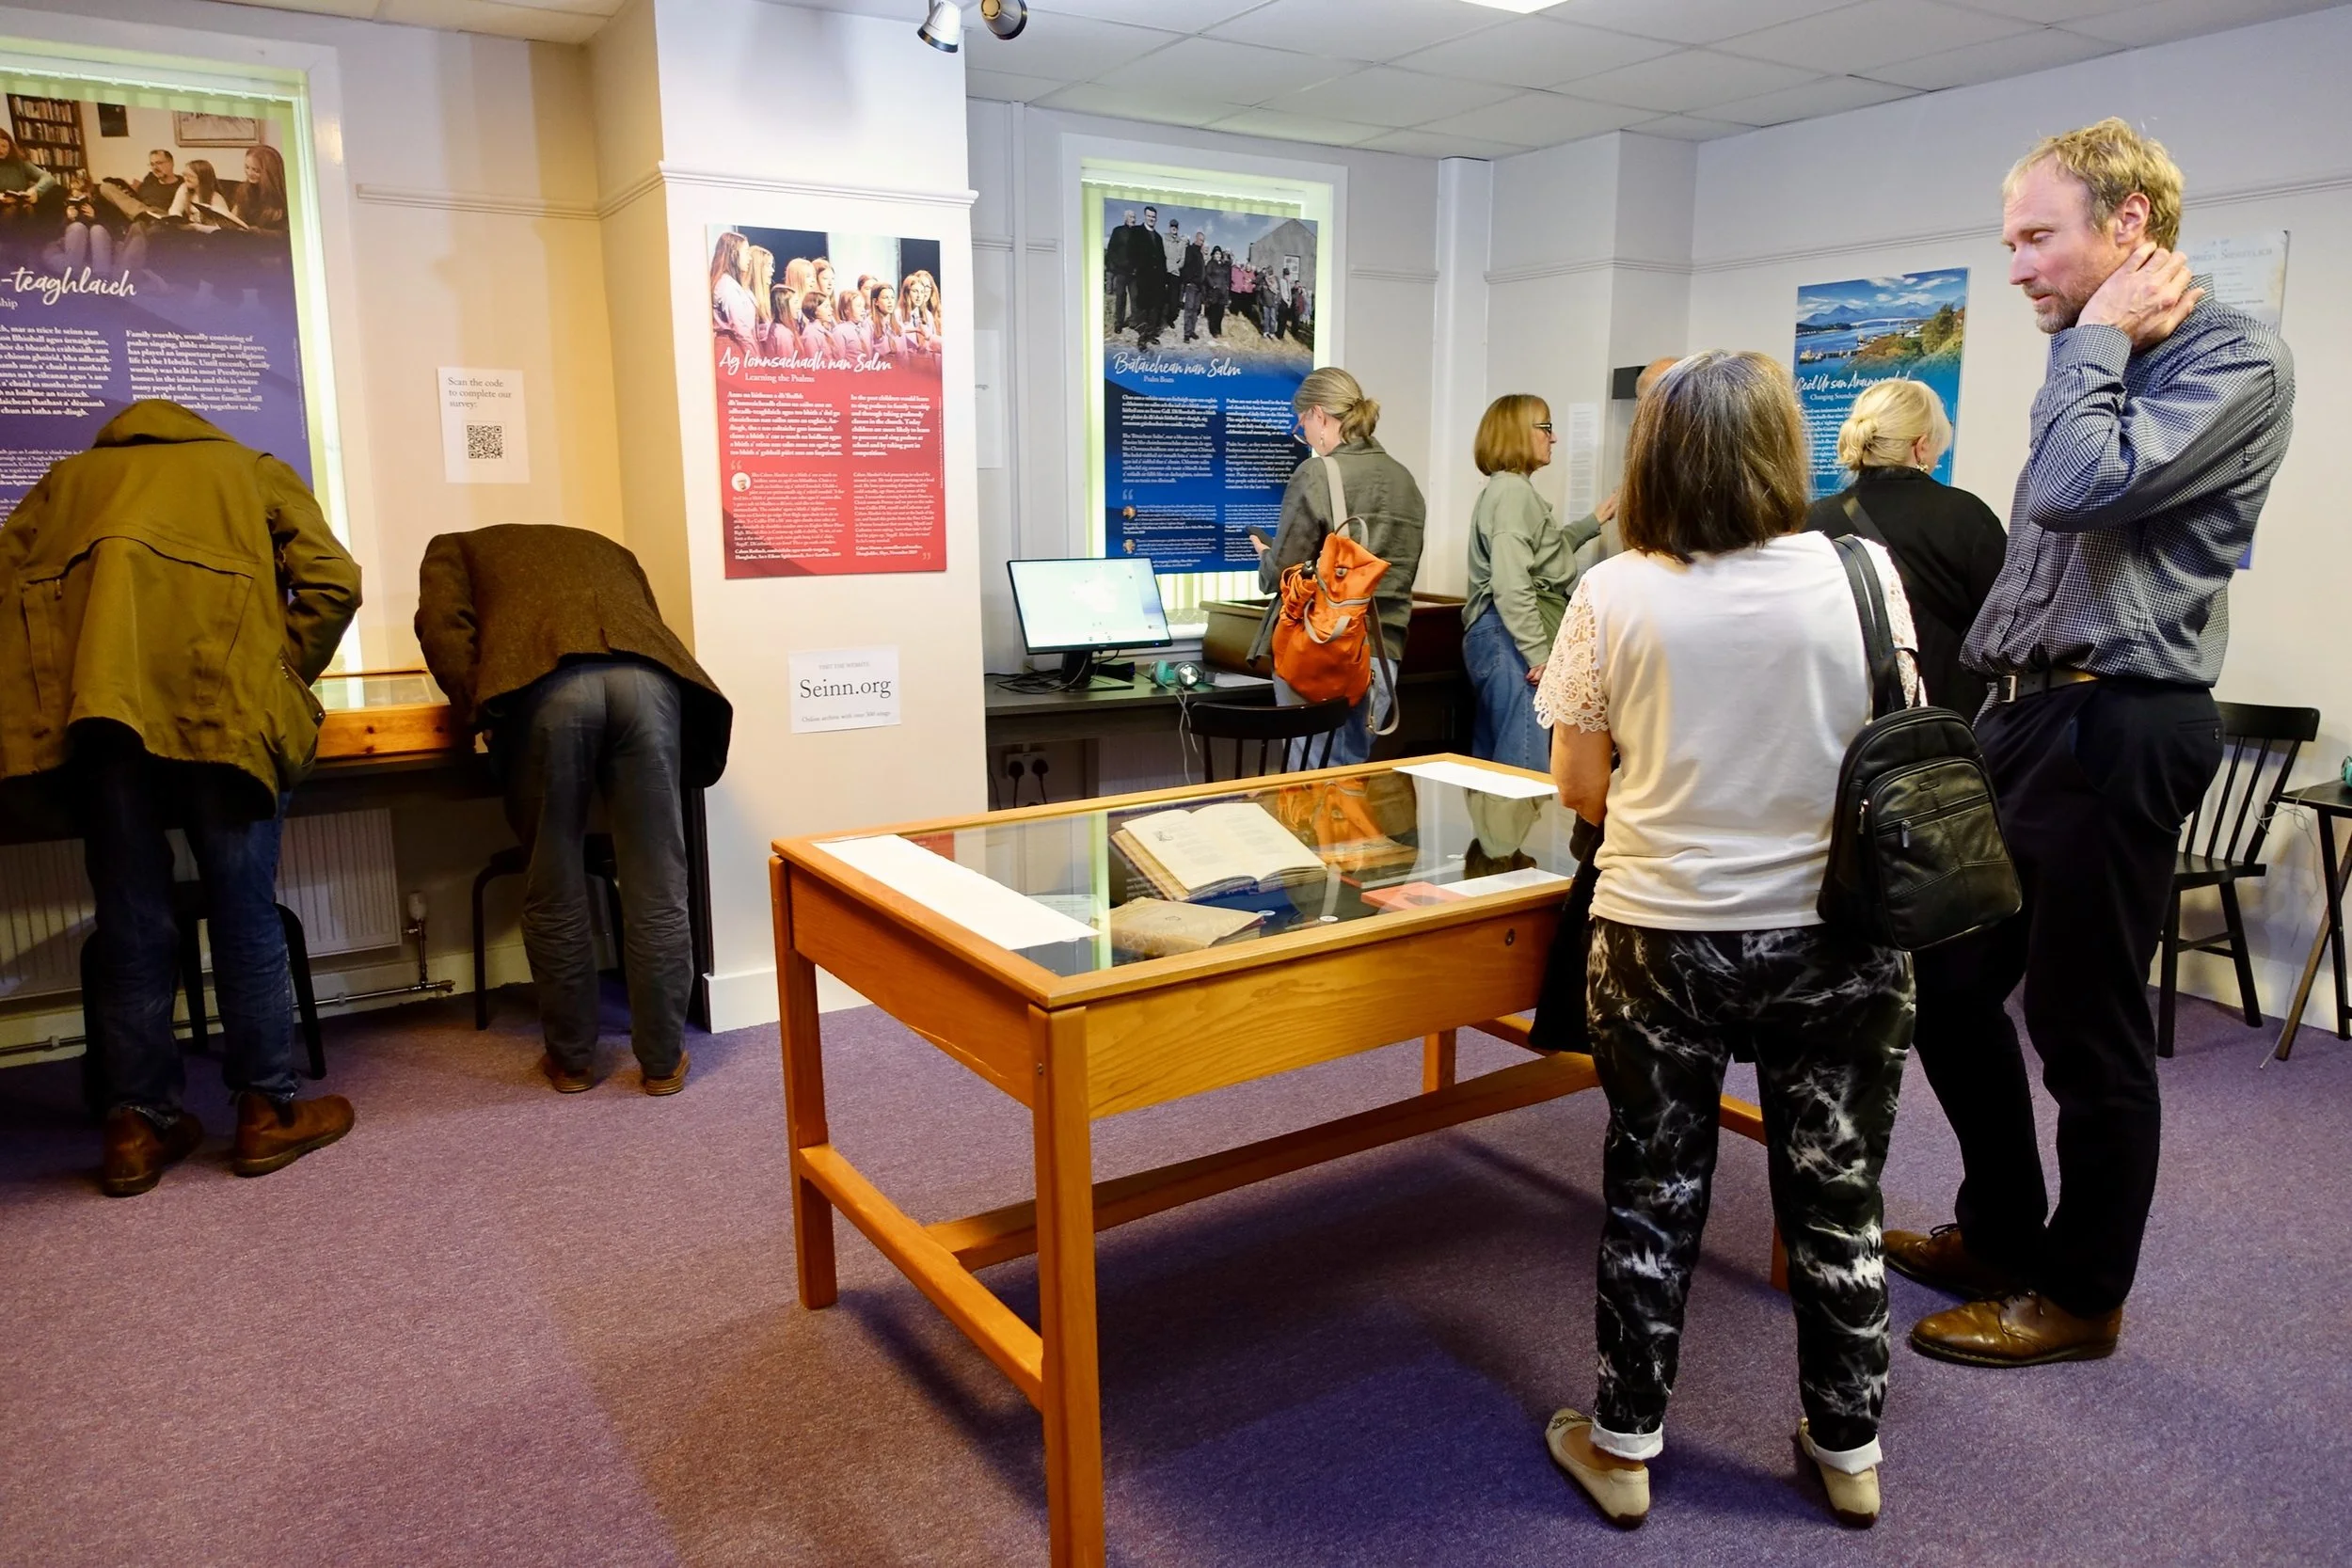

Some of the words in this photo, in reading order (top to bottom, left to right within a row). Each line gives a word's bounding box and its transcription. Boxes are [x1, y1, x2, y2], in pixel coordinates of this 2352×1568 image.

[719, 346, 739, 375] Ag
[828, 357, 852, 370] nan
[853, 352, 892, 372] Salm
[1184, 363, 1205, 374] nan
[1207, 357, 1242, 377] Salm
[448, 377, 468, 386] Scan
[469, 378, 483, 387] the
[745, 372, 776, 383] Learning
[777, 373, 790, 382] the
[791, 373, 815, 382] Psalms
[459, 389, 496, 399] complete
[800, 679, 892, 698] Seinn.org
